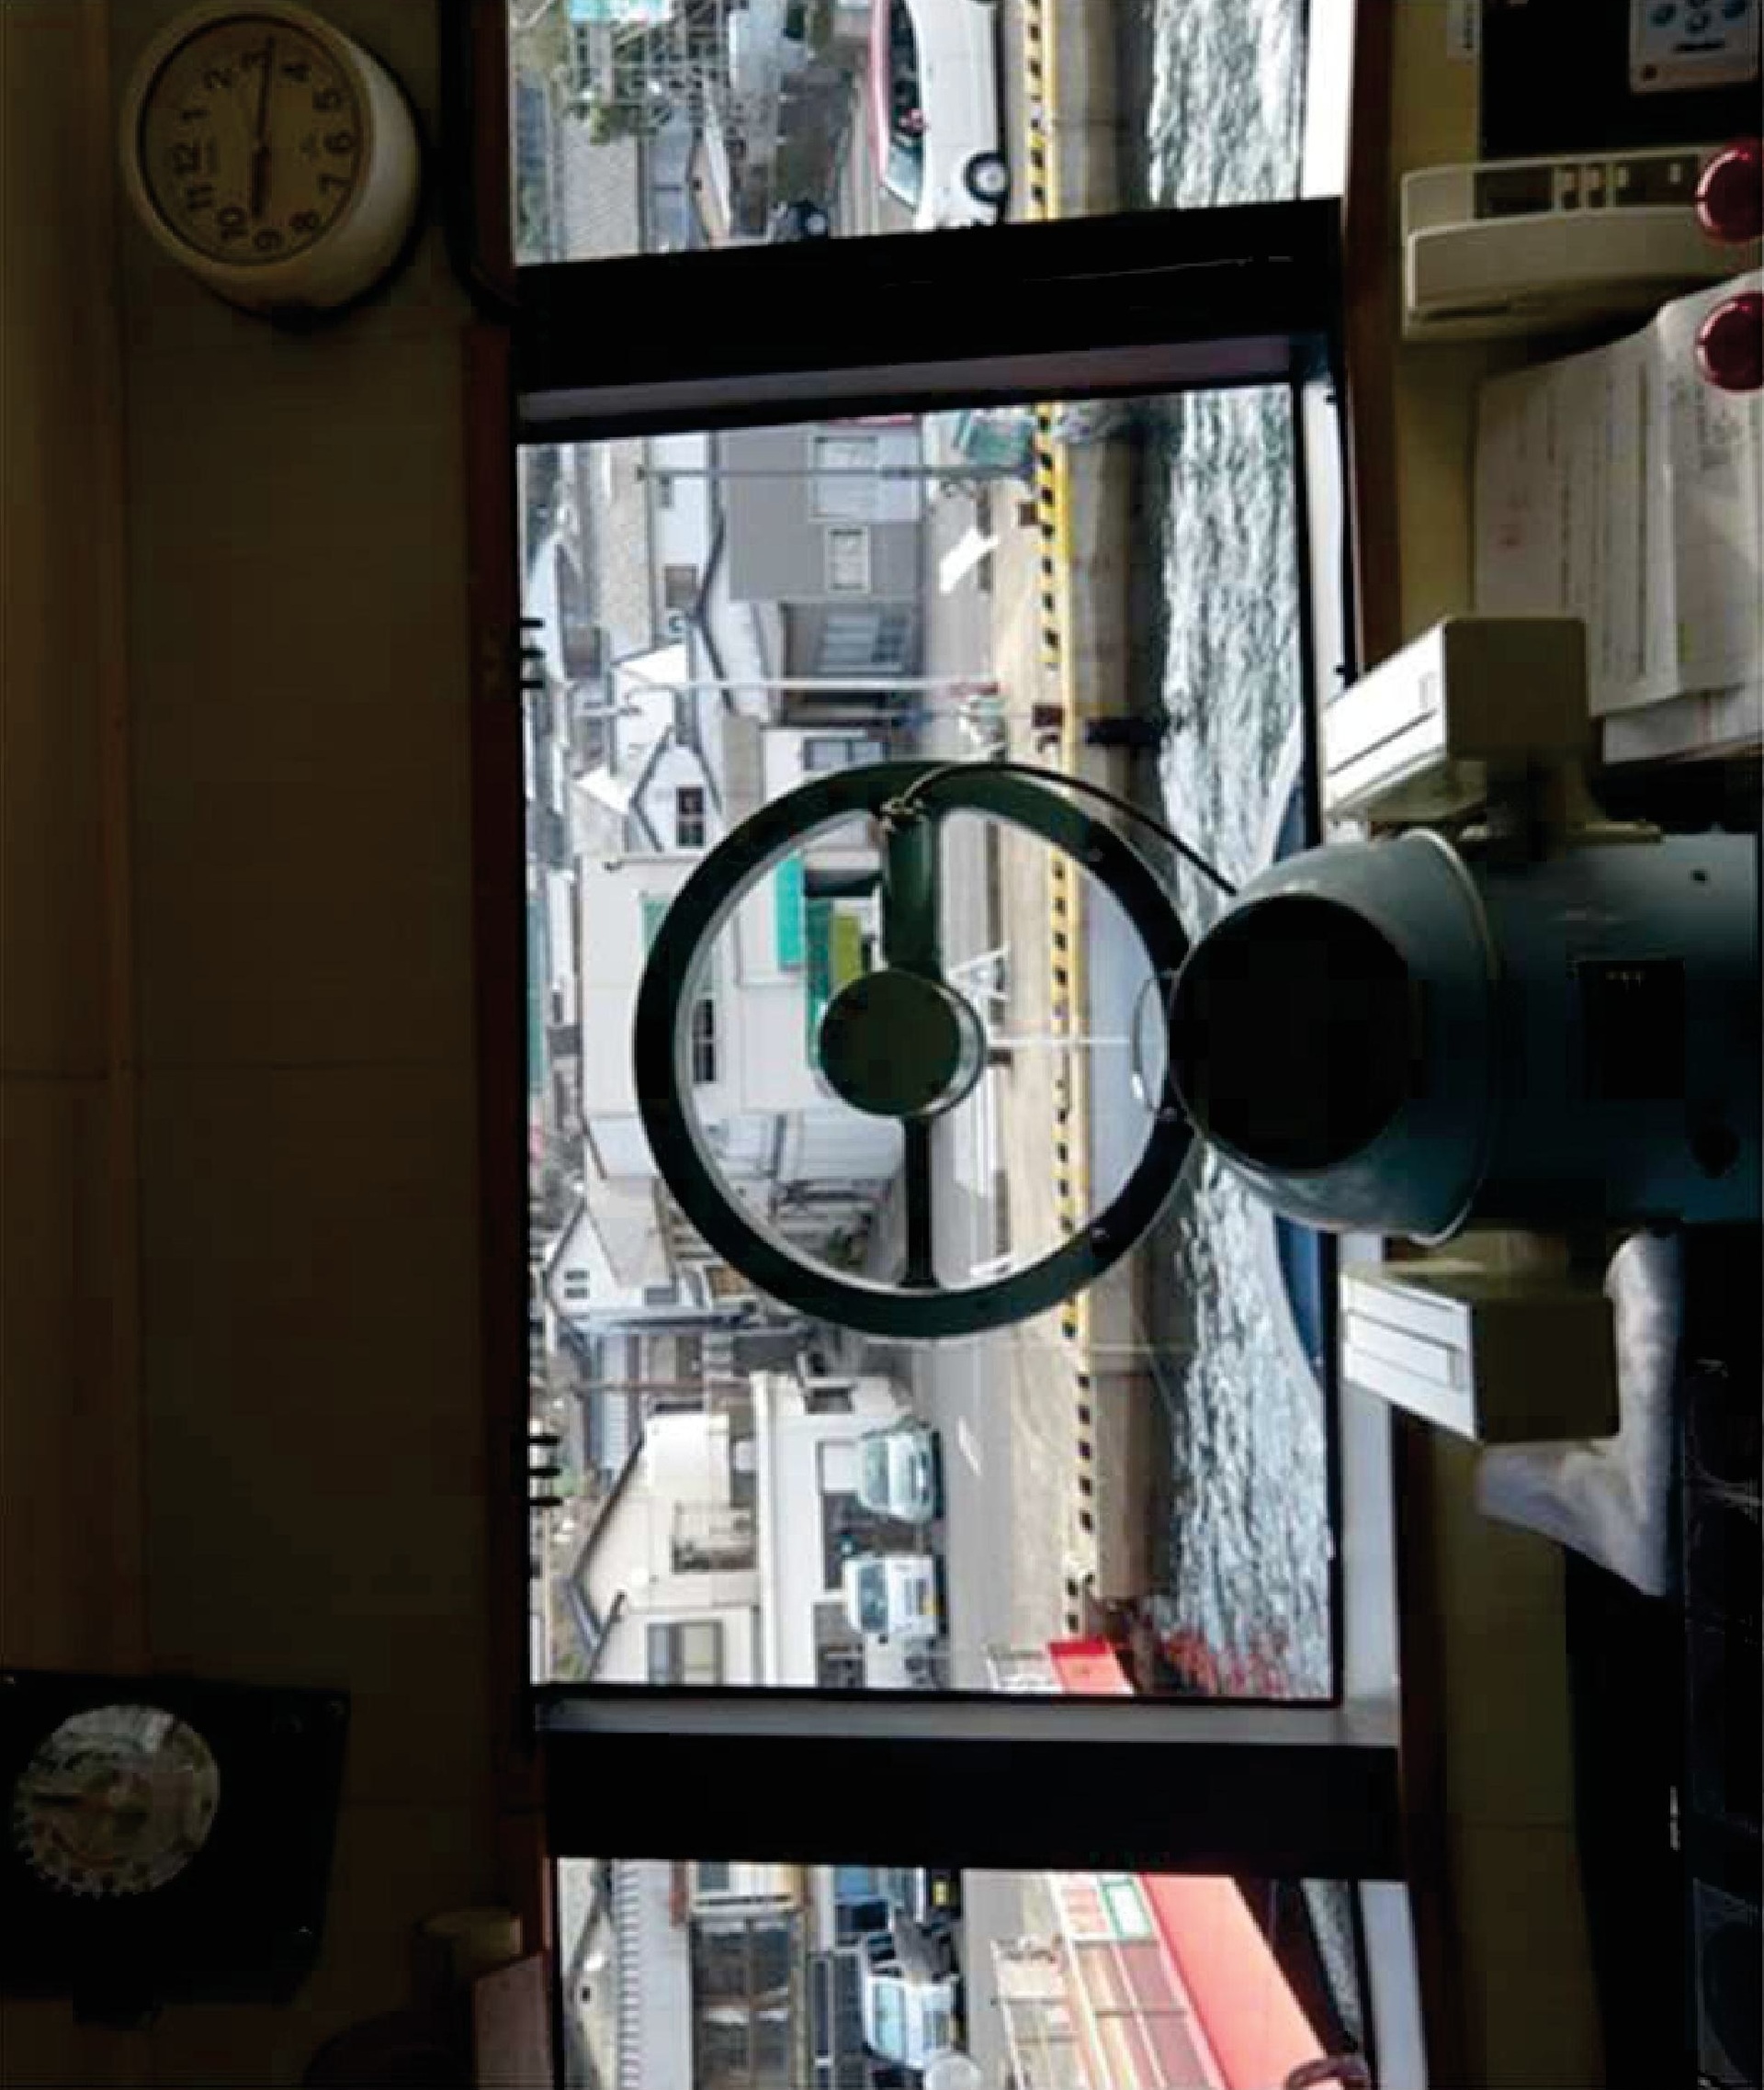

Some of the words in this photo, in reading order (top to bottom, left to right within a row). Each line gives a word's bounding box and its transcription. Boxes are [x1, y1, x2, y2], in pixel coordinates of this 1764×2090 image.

[204, 70, 232, 90] 2
[313, 89, 342, 111] 5
[182, 107, 209, 121] 1
[324, 130, 353, 152] 6
[172, 142, 200, 174] 12
[319, 173, 349, 194] 7
[187, 183, 212, 210] 11
[219, 206, 248, 241] 10
[254, 228, 283, 250] 9
